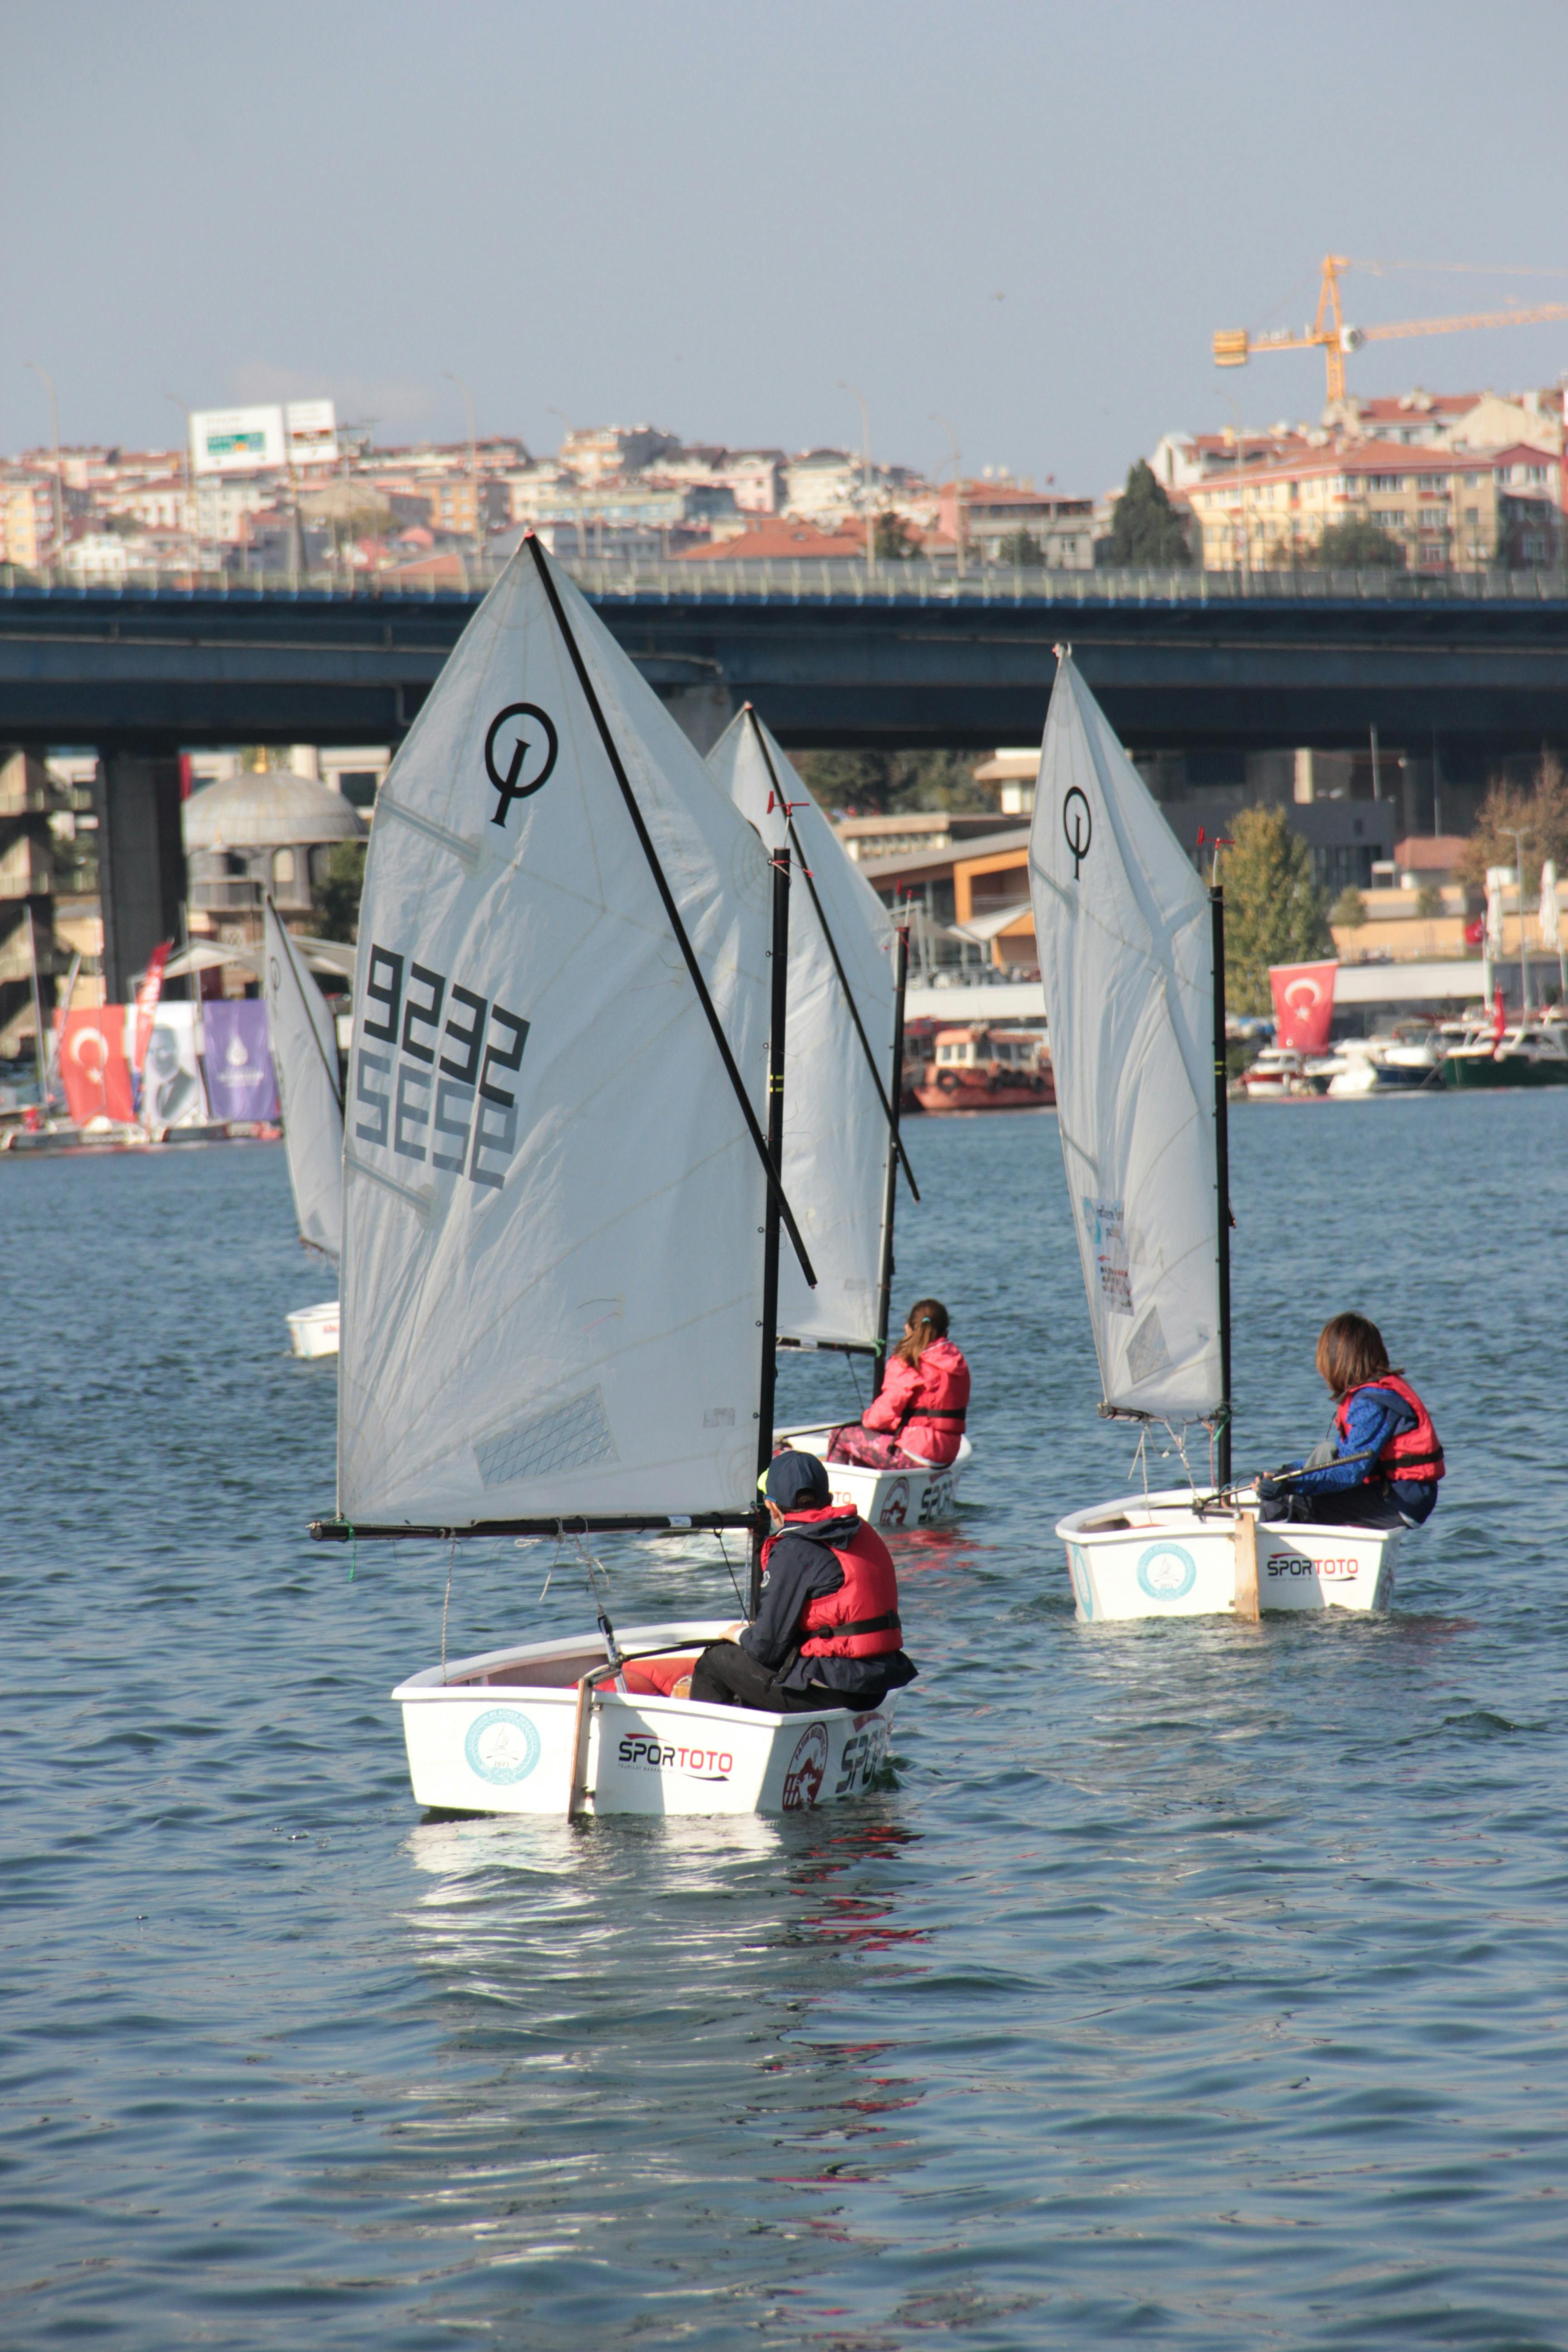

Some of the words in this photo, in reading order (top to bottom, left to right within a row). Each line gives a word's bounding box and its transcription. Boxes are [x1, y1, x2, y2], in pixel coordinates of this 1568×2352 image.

[364, 944, 530, 1108] 9232
[1267, 1559, 1358, 1576] SPORTOTO
[618, 1741, 733, 1773] SPORTOTO
